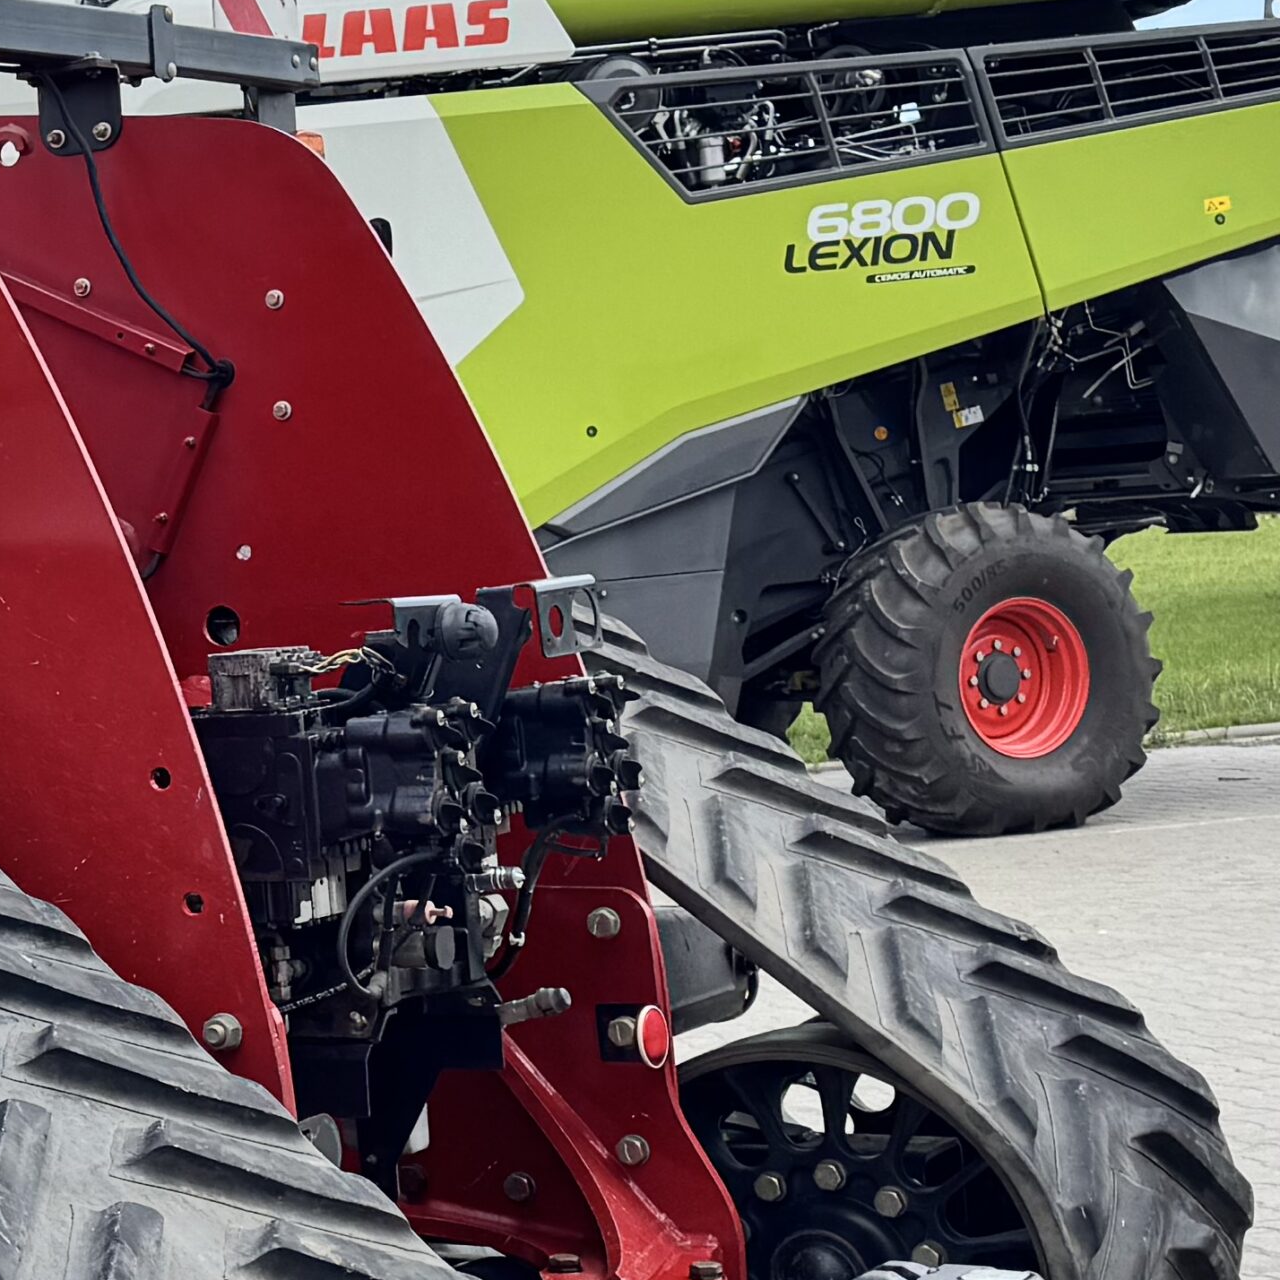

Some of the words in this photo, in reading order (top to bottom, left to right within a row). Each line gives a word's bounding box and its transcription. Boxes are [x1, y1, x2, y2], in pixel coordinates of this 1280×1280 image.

[807, 192, 980, 243] 6800
[784, 228, 956, 274] LEXION
[911, 266, 968, 279] AUTOMATIC
